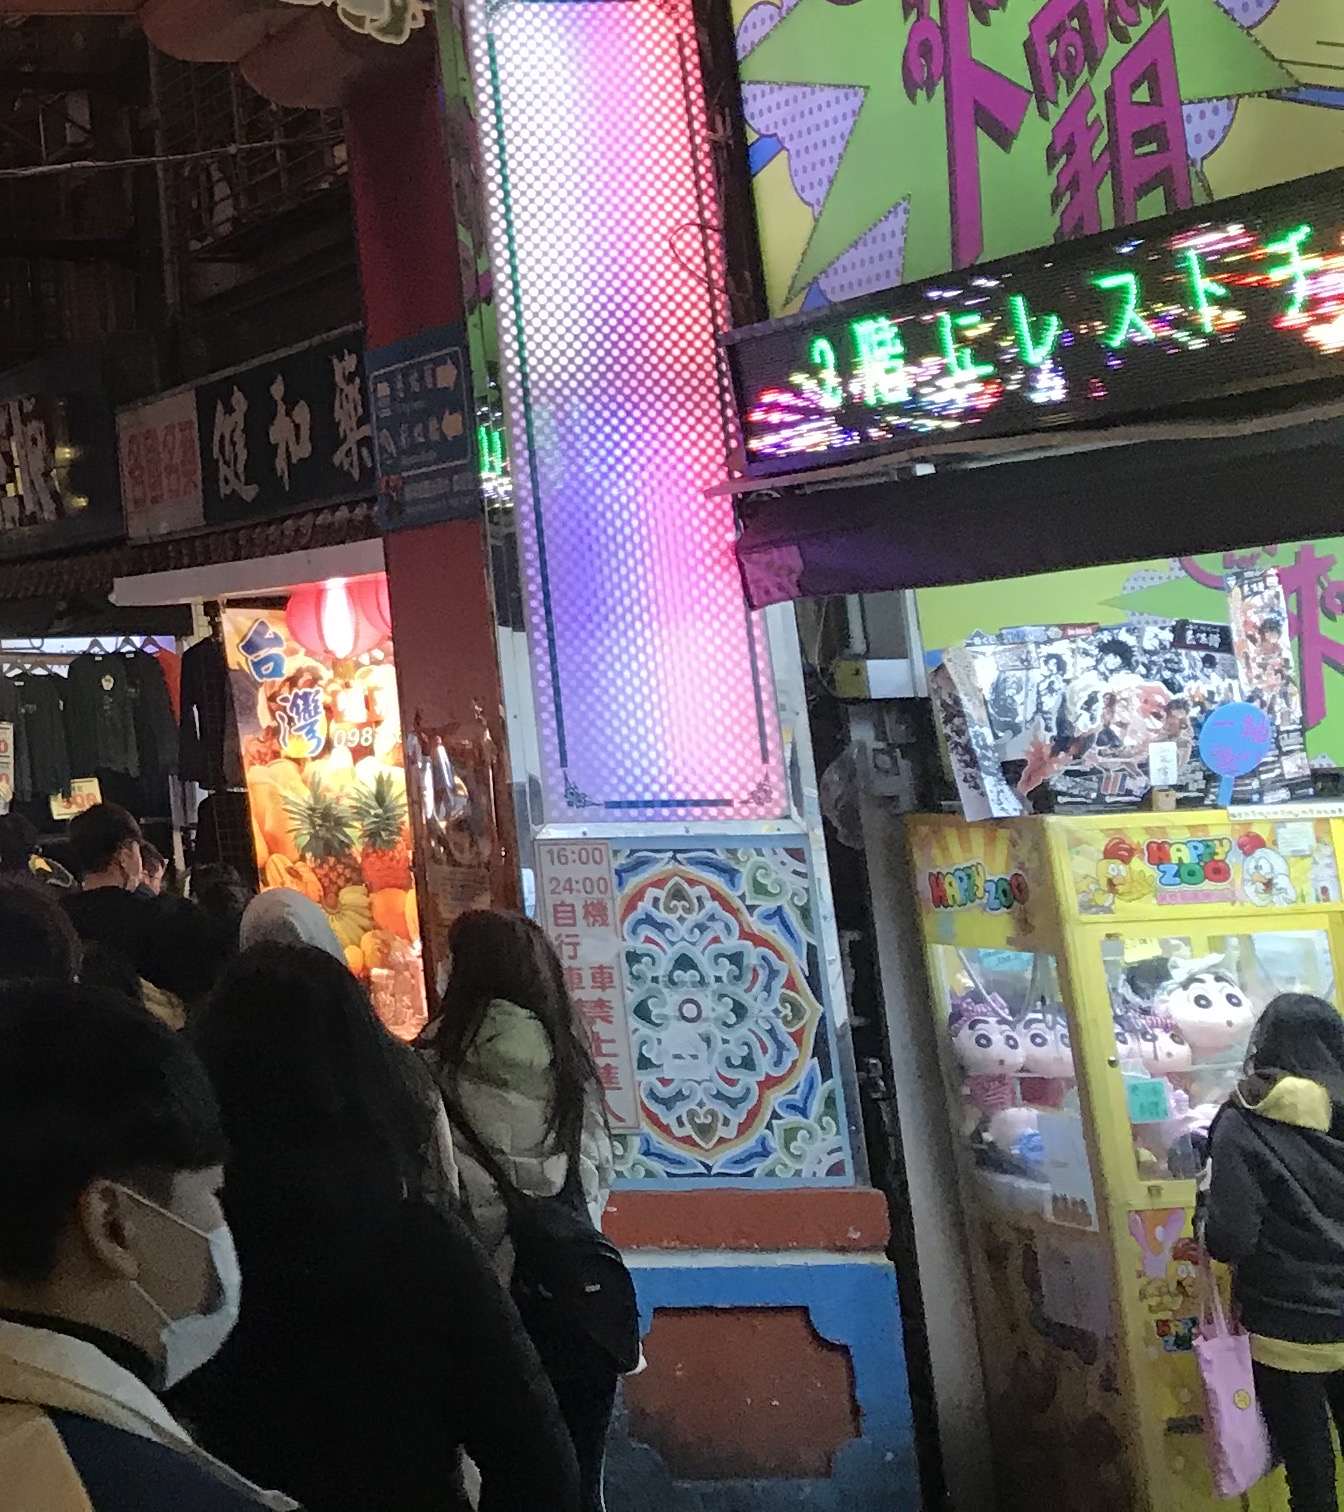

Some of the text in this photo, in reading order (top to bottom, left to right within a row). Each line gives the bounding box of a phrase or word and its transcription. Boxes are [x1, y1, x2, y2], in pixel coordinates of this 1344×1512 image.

[547, 846, 605, 867] 16:00
[1145, 837, 1232, 866] HAPPY
[548, 875, 610, 896] 24:00
[1157, 860, 1232, 886] ZOO
[928, 861, 1030, 912] HAPPY ZOO
